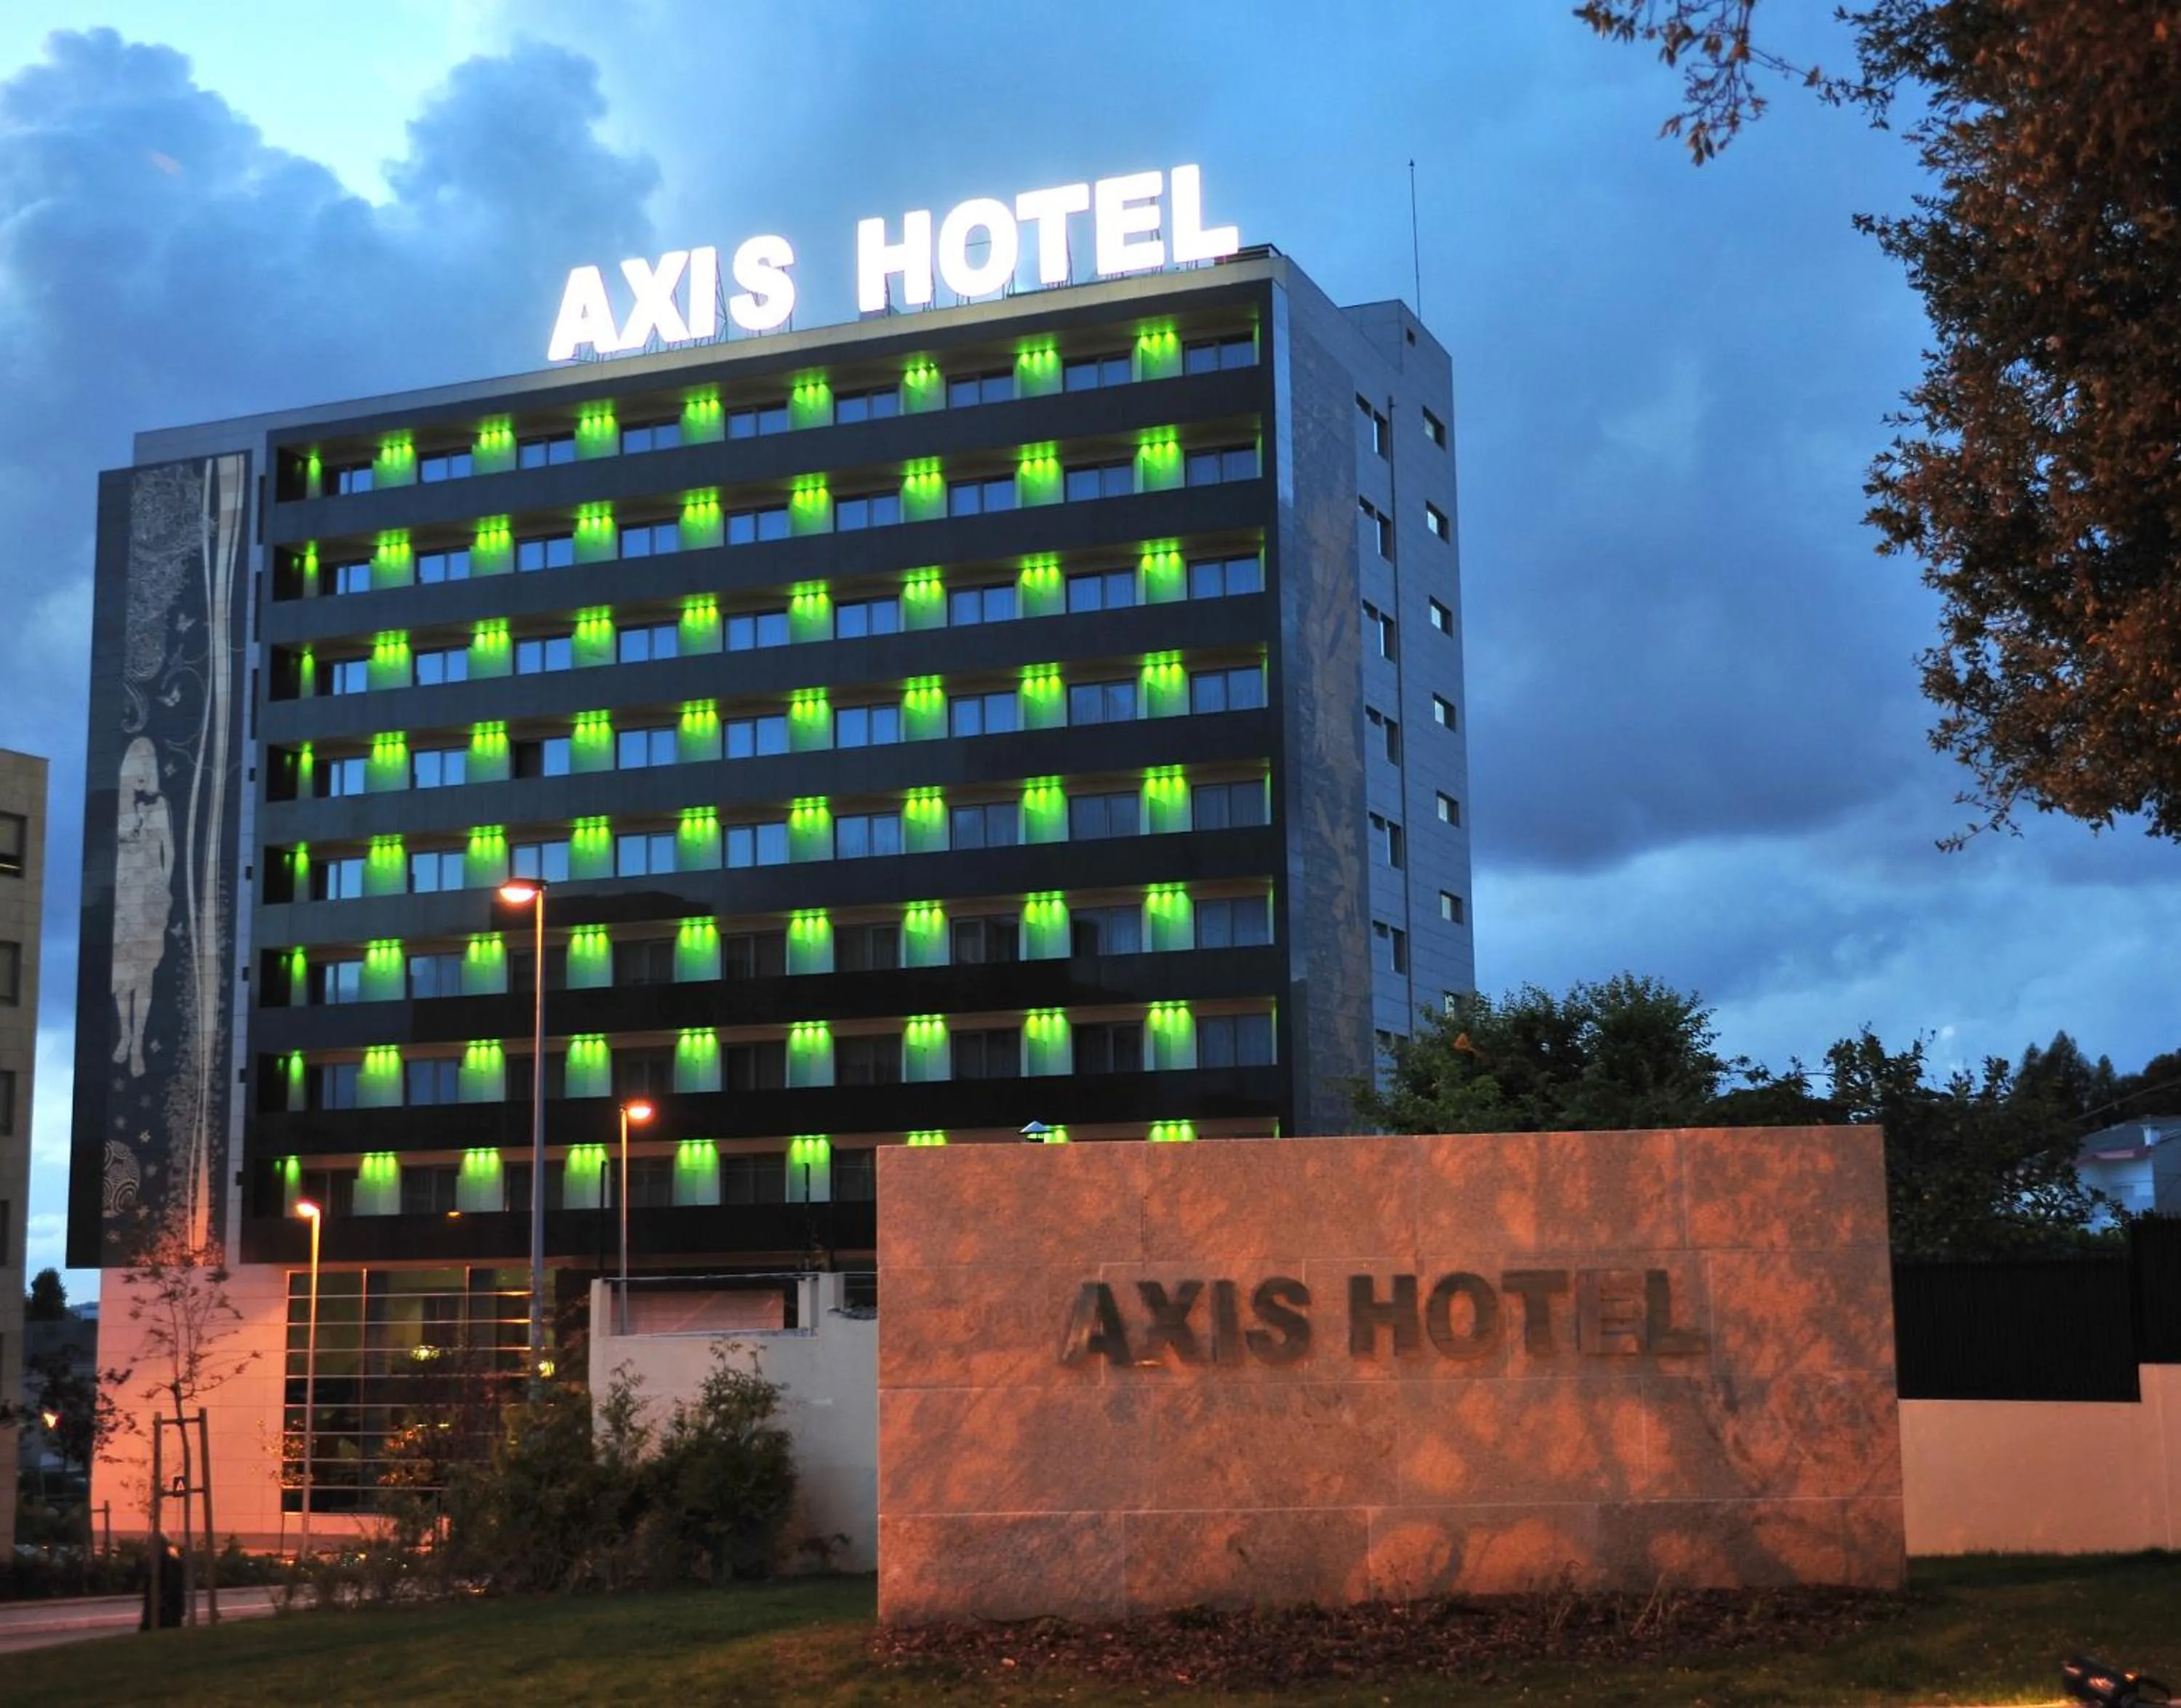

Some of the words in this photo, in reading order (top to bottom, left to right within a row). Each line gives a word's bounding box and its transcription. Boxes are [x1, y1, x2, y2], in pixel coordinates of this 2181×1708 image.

[547, 235, 795, 362] AXIS
[857, 164, 1239, 312] HOTEL
[1061, 1275, 1311, 1368] AXIS
[1346, 1268, 1708, 1360] HOTEL
